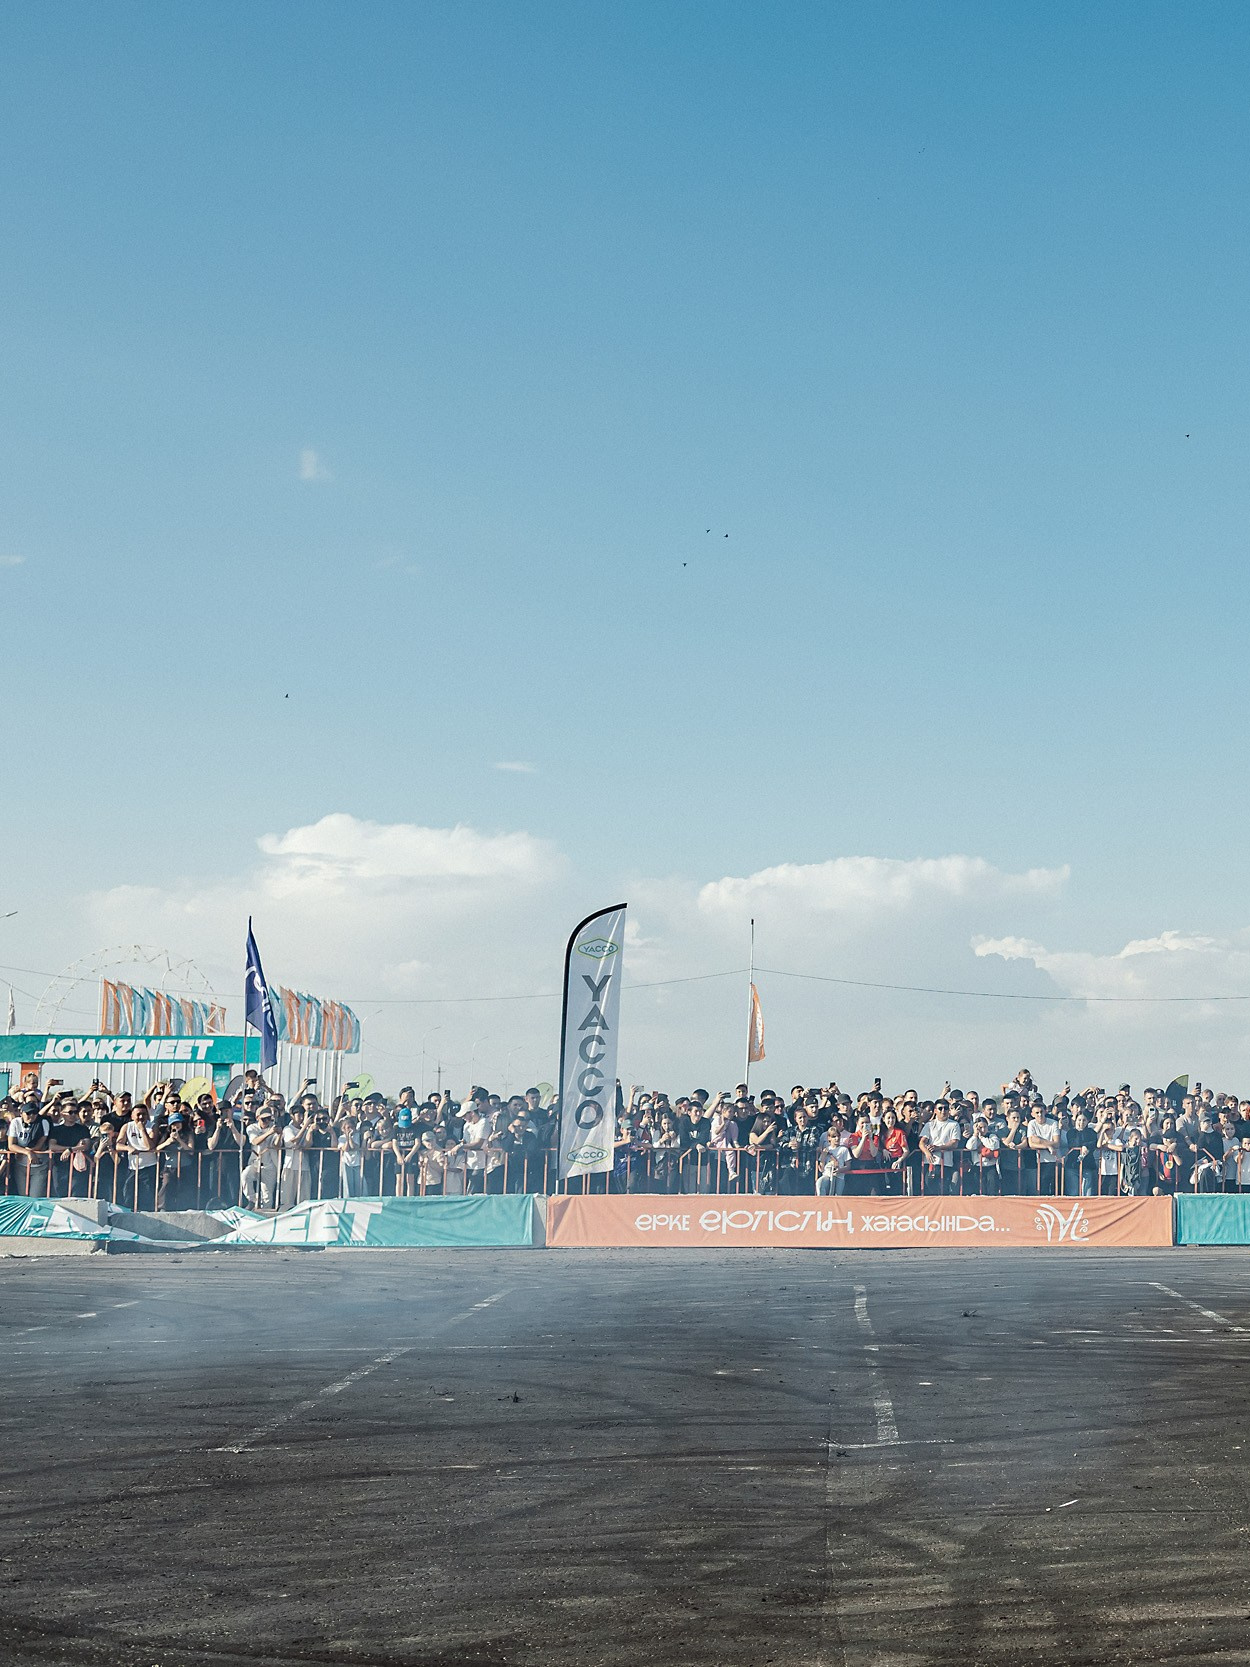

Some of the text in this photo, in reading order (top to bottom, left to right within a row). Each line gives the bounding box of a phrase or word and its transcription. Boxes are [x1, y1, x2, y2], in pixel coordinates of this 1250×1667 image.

[583, 944, 615, 953] YACCO
[43, 1039, 213, 1060] LOWKZMEET
[574, 975, 612, 1130] YACCO
[571, 1151, 604, 1160] YACCO
